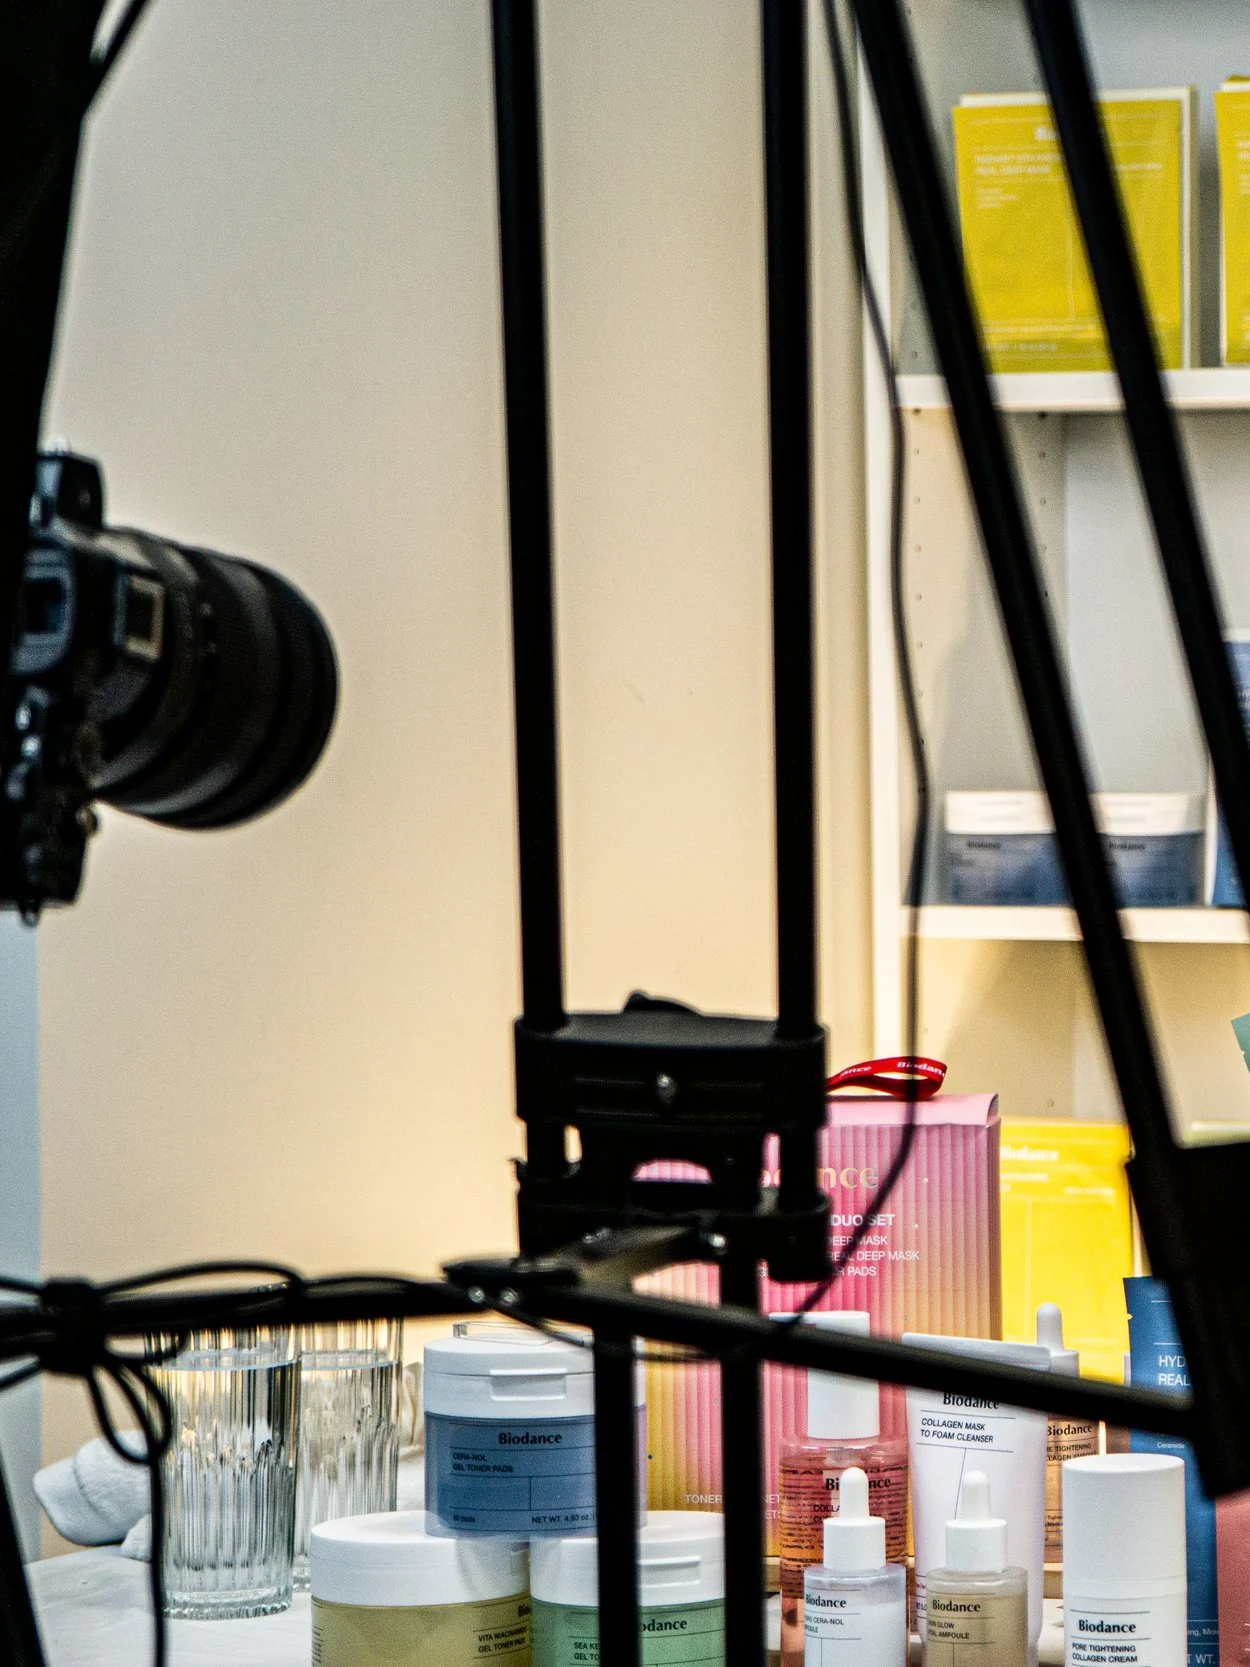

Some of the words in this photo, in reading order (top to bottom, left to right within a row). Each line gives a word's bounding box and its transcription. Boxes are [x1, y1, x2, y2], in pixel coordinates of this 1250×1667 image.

[830, 1214, 863, 1227] DUO
[869, 1213, 895, 1226] SET
[856, 1251, 886, 1261] DEEP
[887, 1250, 920, 1261] MASK
[847, 1266, 877, 1276] PADS
[1159, 1355, 1186, 1368] HYD
[1158, 1373, 1191, 1386] REAL
[921, 1417, 963, 1430] COLLAGEN
[965, 1422, 986, 1431] MASK
[499, 1432, 562, 1445] Biodance
[920, 1429, 931, 1437] TO
[932, 1431, 955, 1440] FOAM
[957, 1433, 994, 1444] CLEANSER
[1055, 1442, 1092, 1452] TIGHTENING
[453, 1453, 487, 1461] CERA-NOL
[453, 1463, 465, 1471] GEL
[467, 1464, 491, 1472] TONER
[685, 1494, 723, 1504] TONER
[814, 1504, 840, 1512] COLLA
[531, 1516, 546, 1524] NET
[932, 1599, 981, 1613] Biodance
[813, 1617, 844, 1626] CERA-NOL
[937, 1621, 955, 1630] GLOW
[1078, 1619, 1137, 1634] Biodance
[478, 1632, 493, 1642] VITA
[938, 1631, 970, 1640] AMPOULE
[478, 1644, 493, 1653] GEL
[494, 1640, 515, 1651] TONER
[574, 1642, 588, 1650] SEA
[1072, 1642, 1087, 1652] PORE
[1089, 1643, 1136, 1653] TIGHTENING
[574, 1653, 588, 1661] GEL
[1072, 1654, 1106, 1663] COLLAGEN
[1109, 1655, 1138, 1663] CREAM
